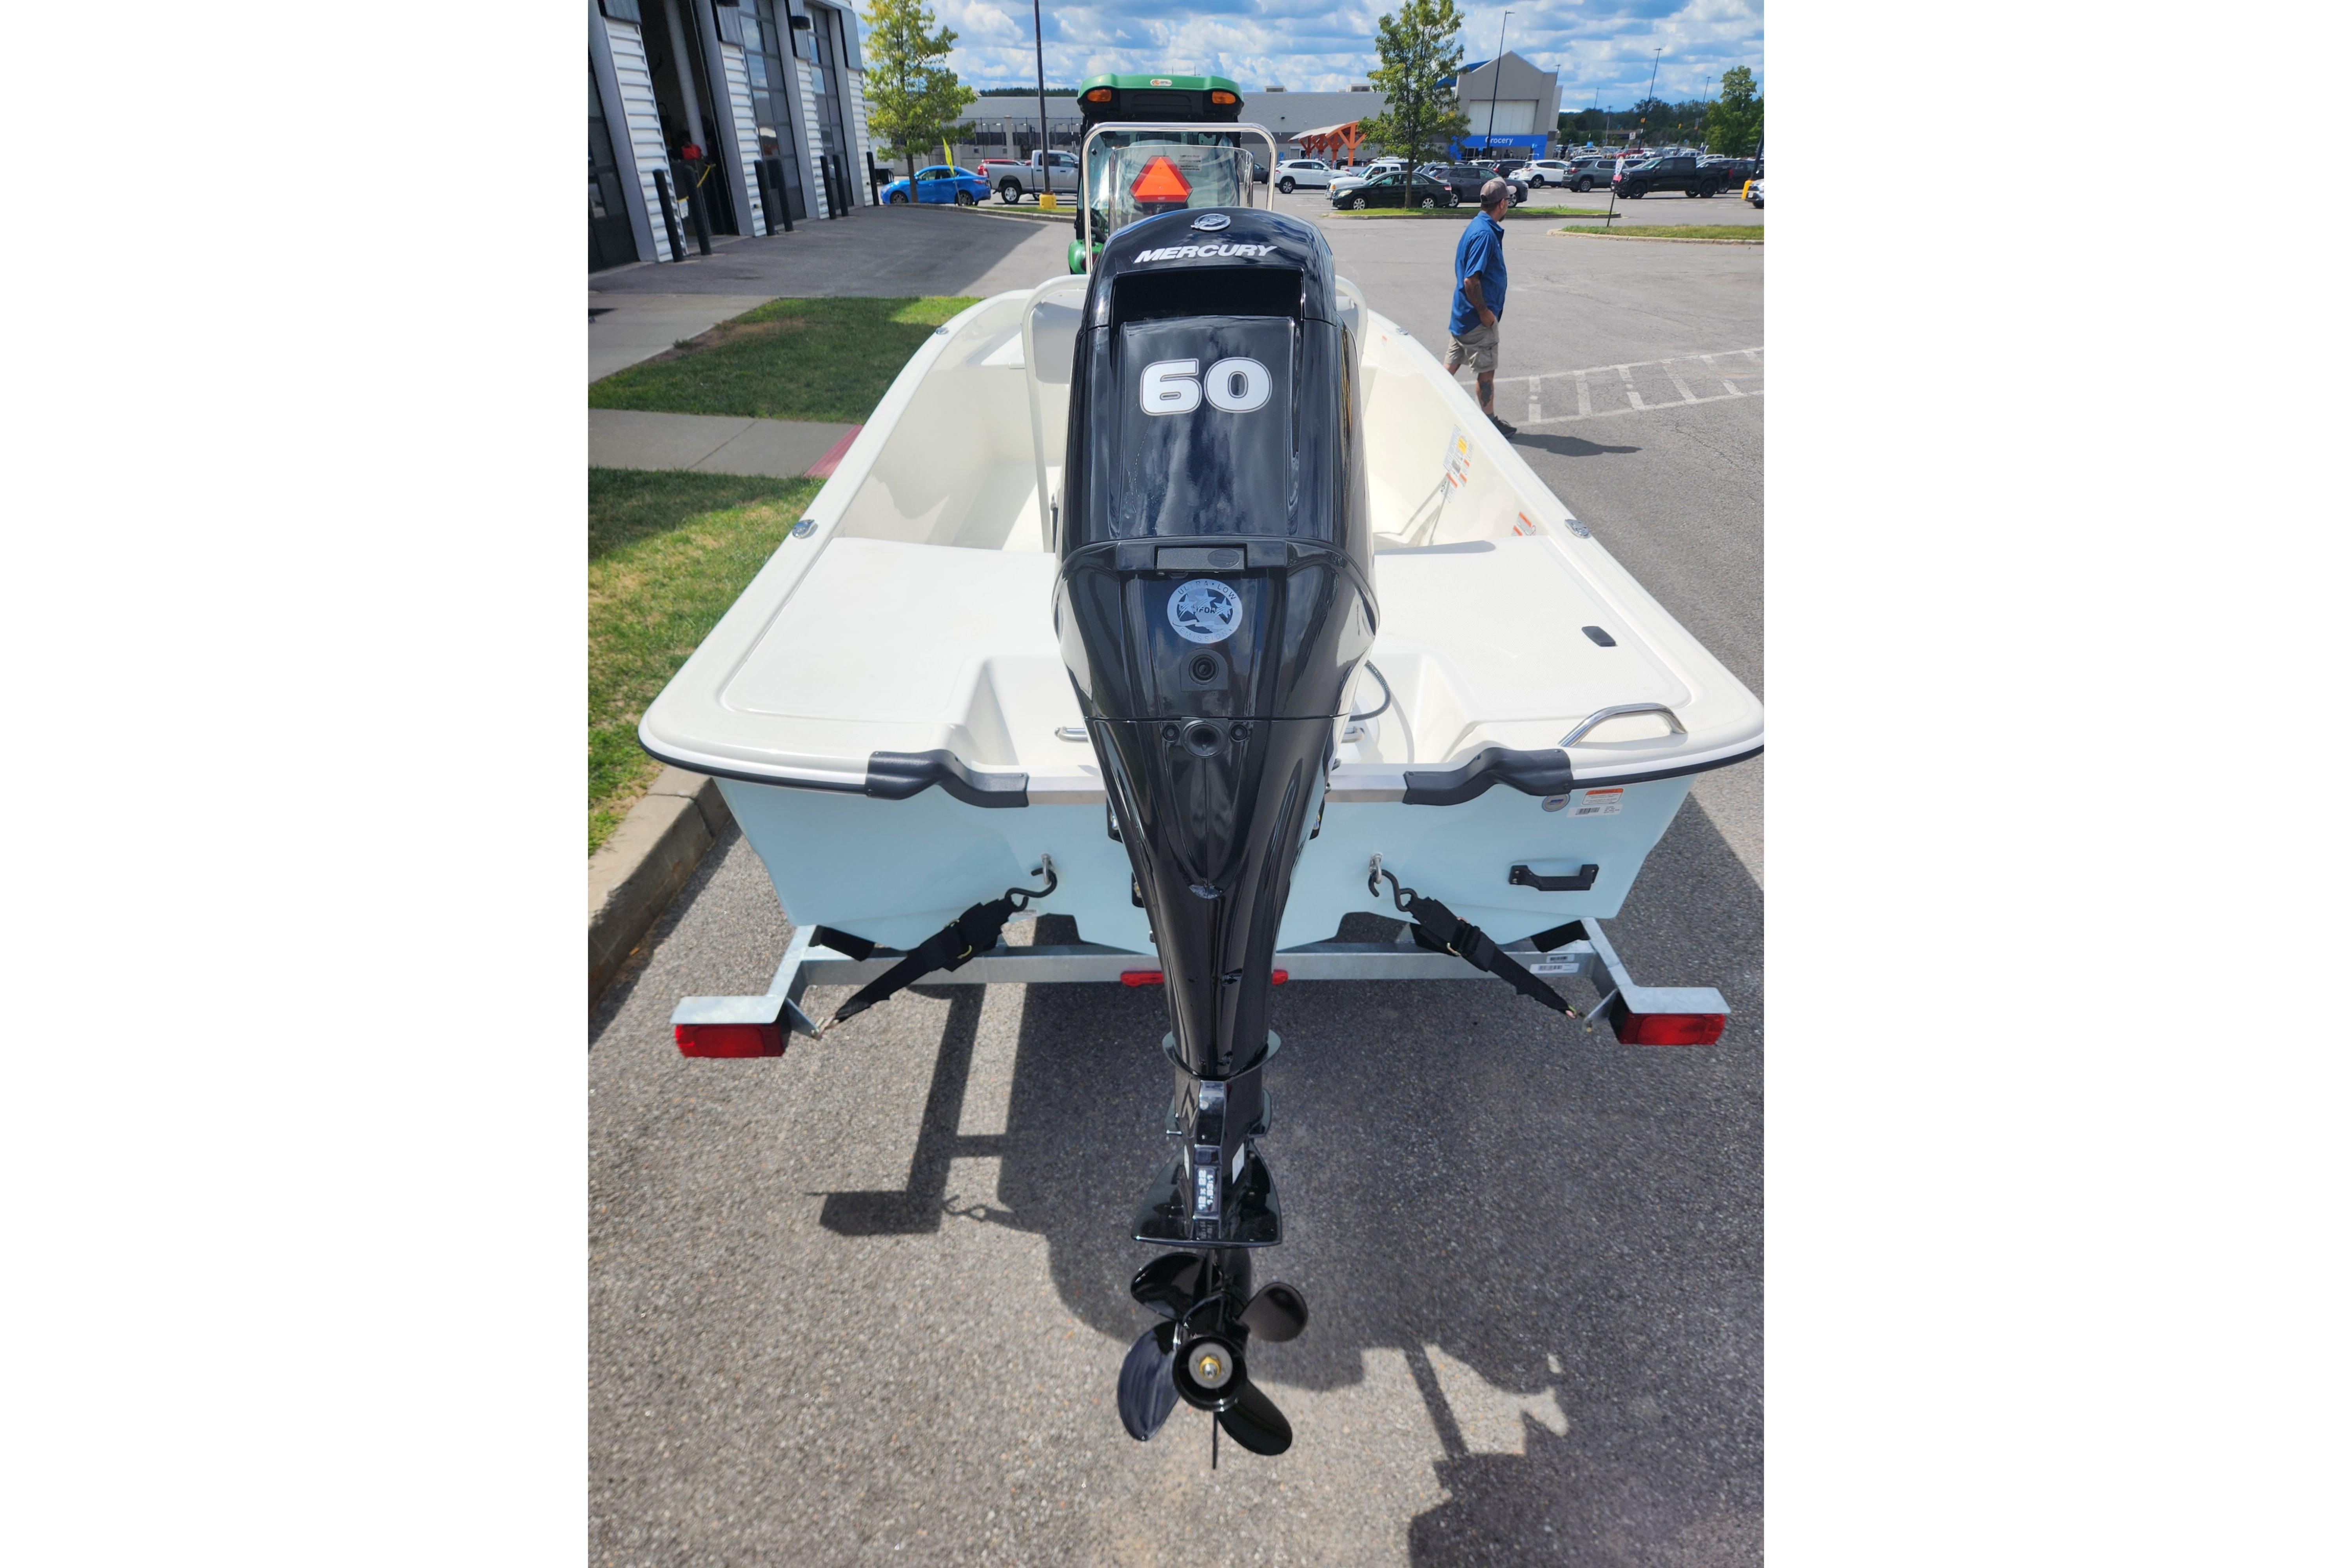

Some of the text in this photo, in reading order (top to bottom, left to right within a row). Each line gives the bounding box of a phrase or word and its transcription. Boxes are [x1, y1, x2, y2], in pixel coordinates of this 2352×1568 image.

[1134, 244, 1277, 263] MERCURY
[1140, 356, 1273, 416] 60
[1217, 583, 1236, 600] LOW
[1179, 627, 1228, 641] EMISSION
[1198, 1170, 1207, 1186] 22
[1198, 1196, 1207, 1210] 12
